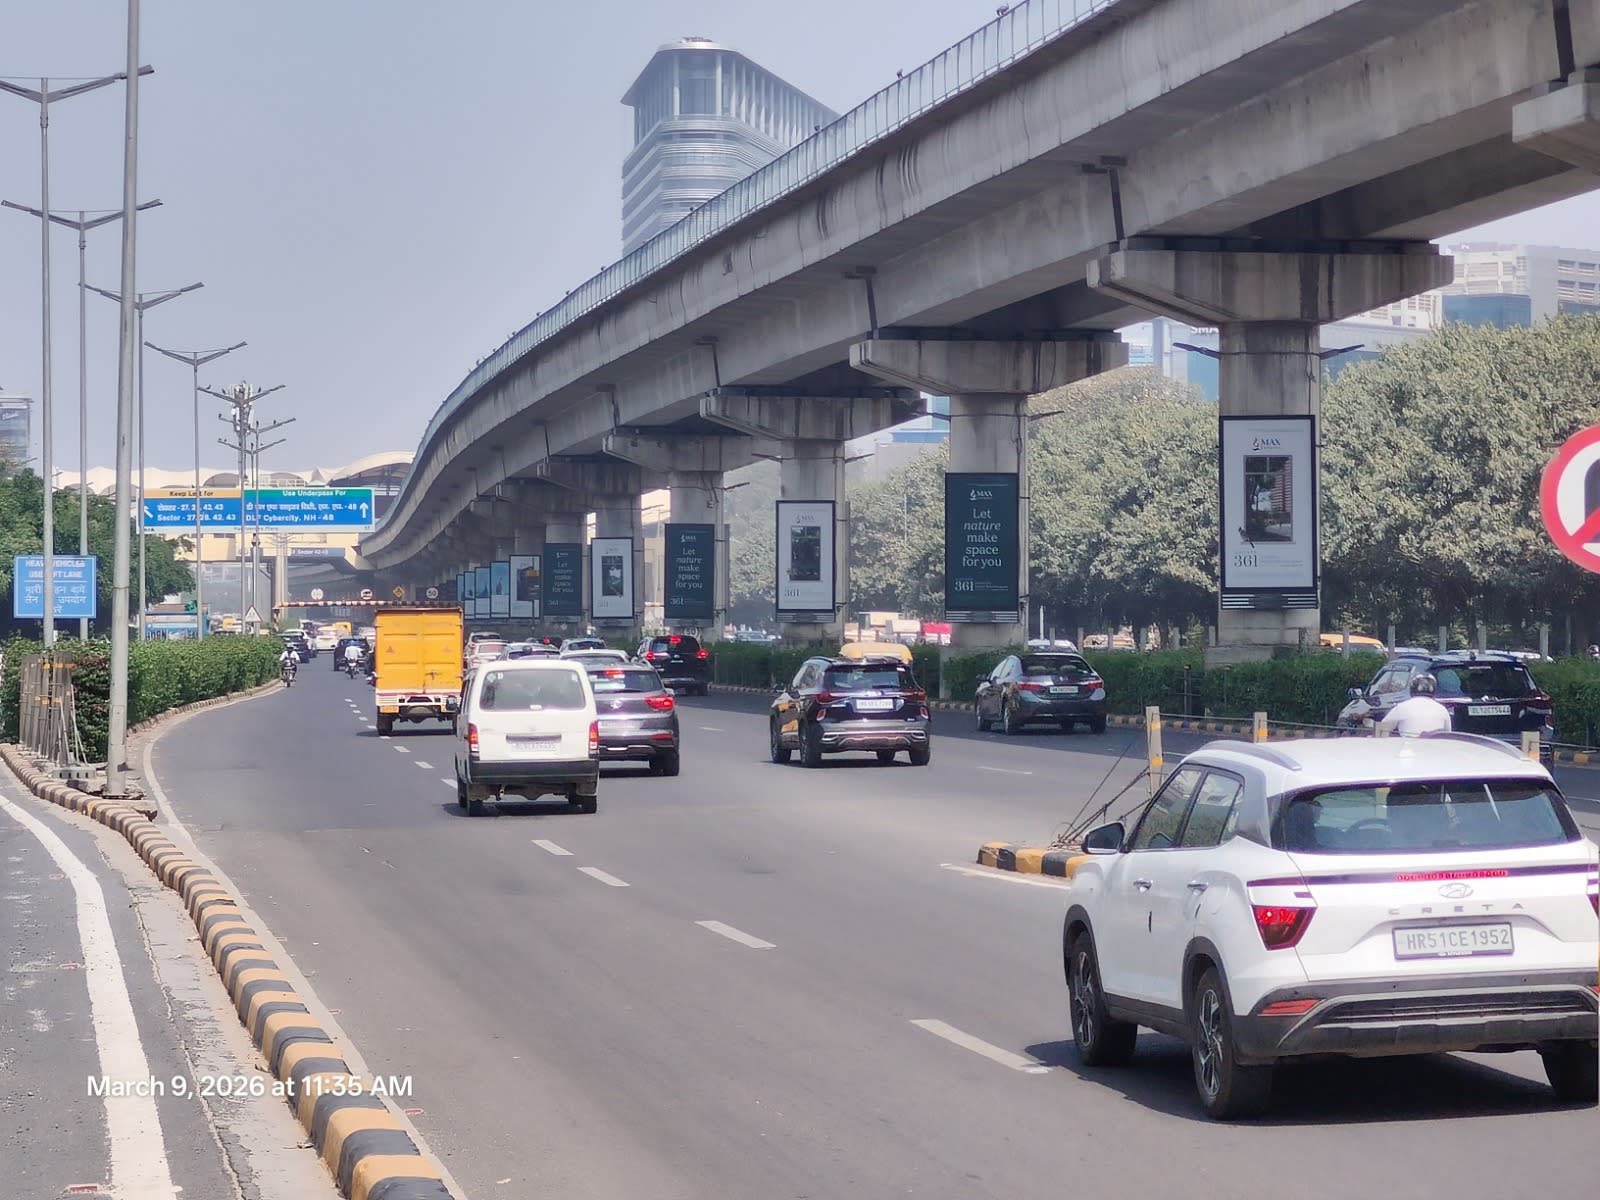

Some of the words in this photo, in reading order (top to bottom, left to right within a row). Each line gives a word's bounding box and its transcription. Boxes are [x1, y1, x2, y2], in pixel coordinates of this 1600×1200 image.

[297, 490, 334, 498] Underpass
[973, 508, 991, 519] Let
[964, 522, 1001, 531] nature
[967, 532, 998, 543] make
[683, 547, 695, 555] Let
[966, 545, 999, 557] space
[962, 556, 980, 567] for
[980, 558, 1002, 569] you
[1234, 555, 1257, 567] 361
[954, 581, 974, 591] 361
[1388, 903, 1524, 915] CRETA
[1406, 929, 1510, 950] HR51CE1952
